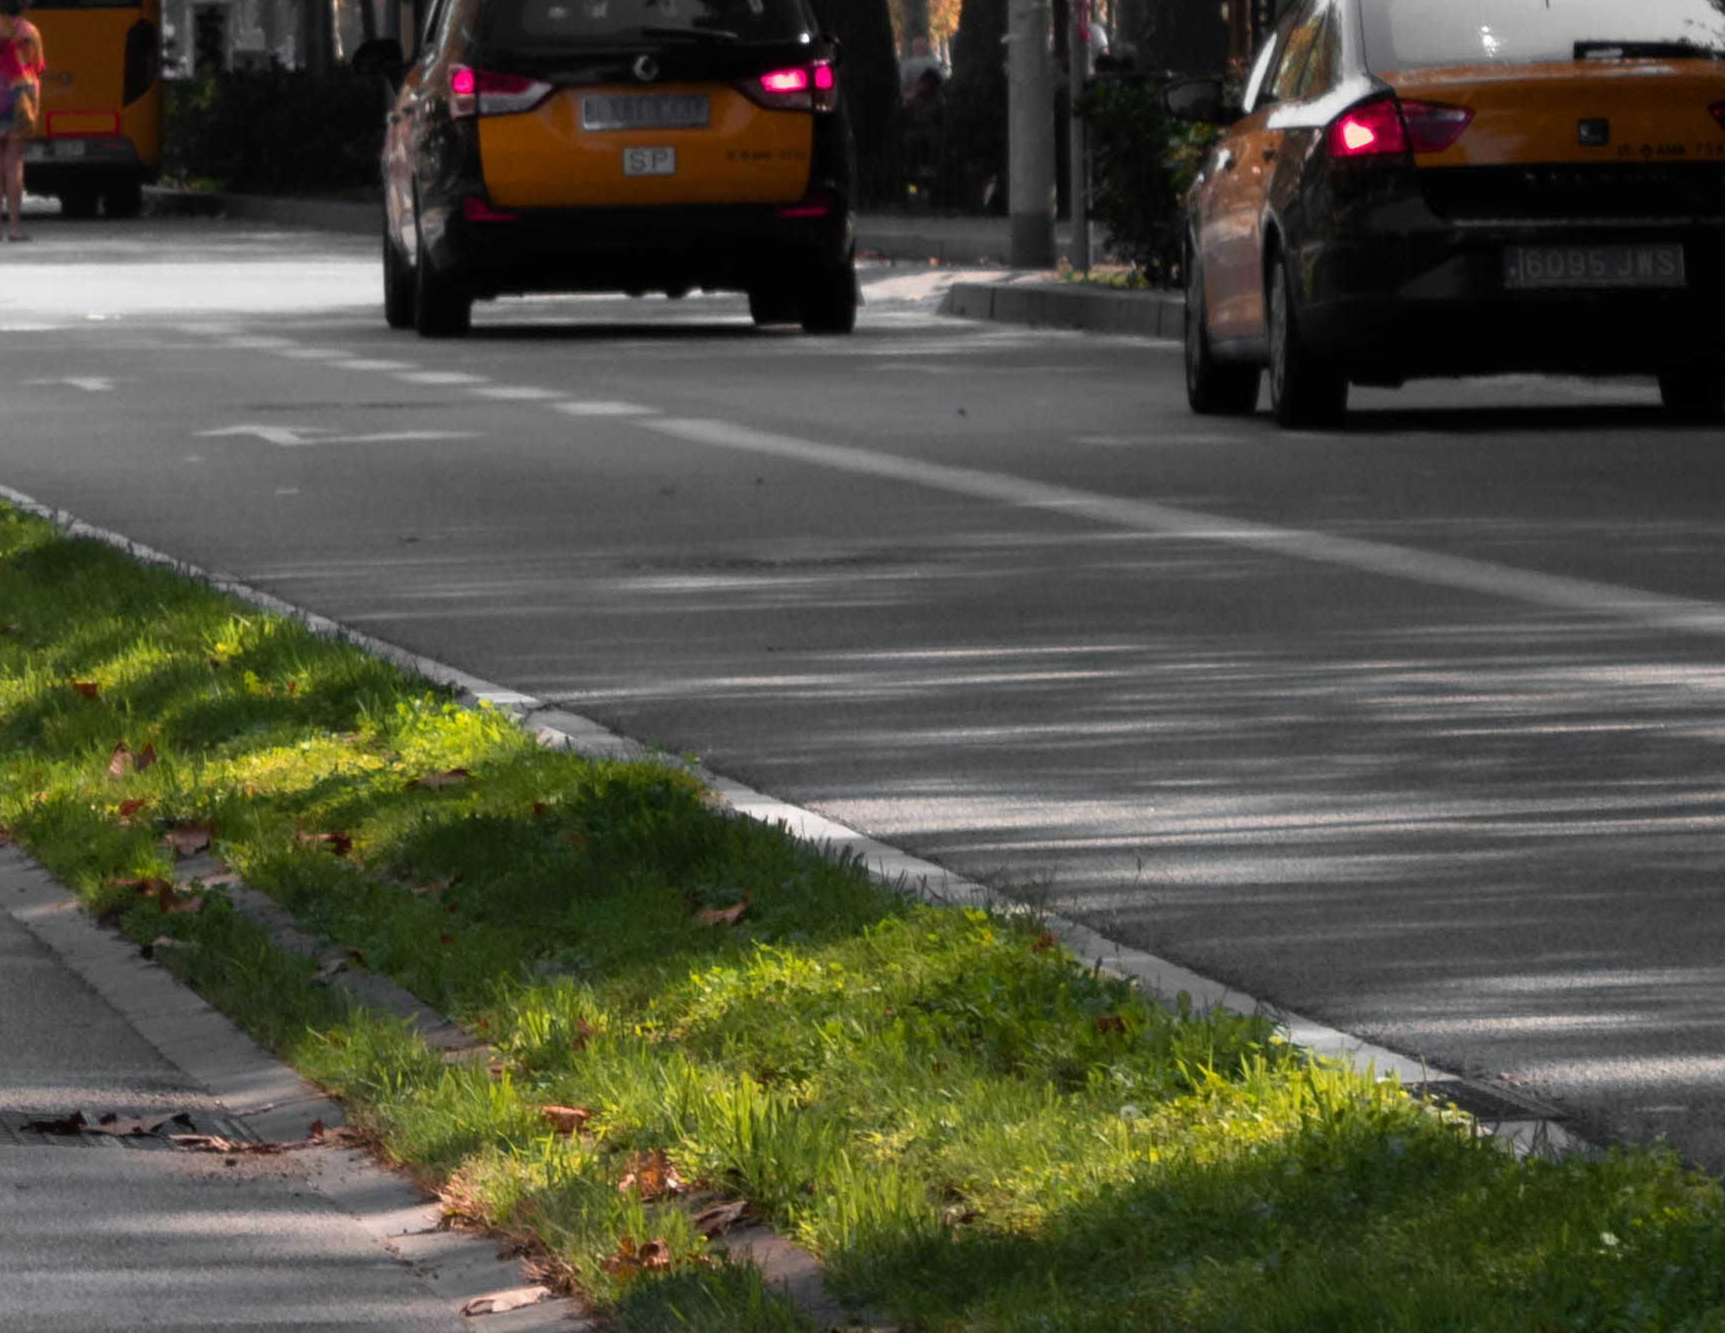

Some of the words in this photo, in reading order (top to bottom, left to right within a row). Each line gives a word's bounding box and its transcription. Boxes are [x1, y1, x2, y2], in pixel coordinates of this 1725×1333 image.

[629, 150, 668, 173] SP
[1525, 250, 1606, 278] 6095
[1618, 249, 1676, 277] JWS
